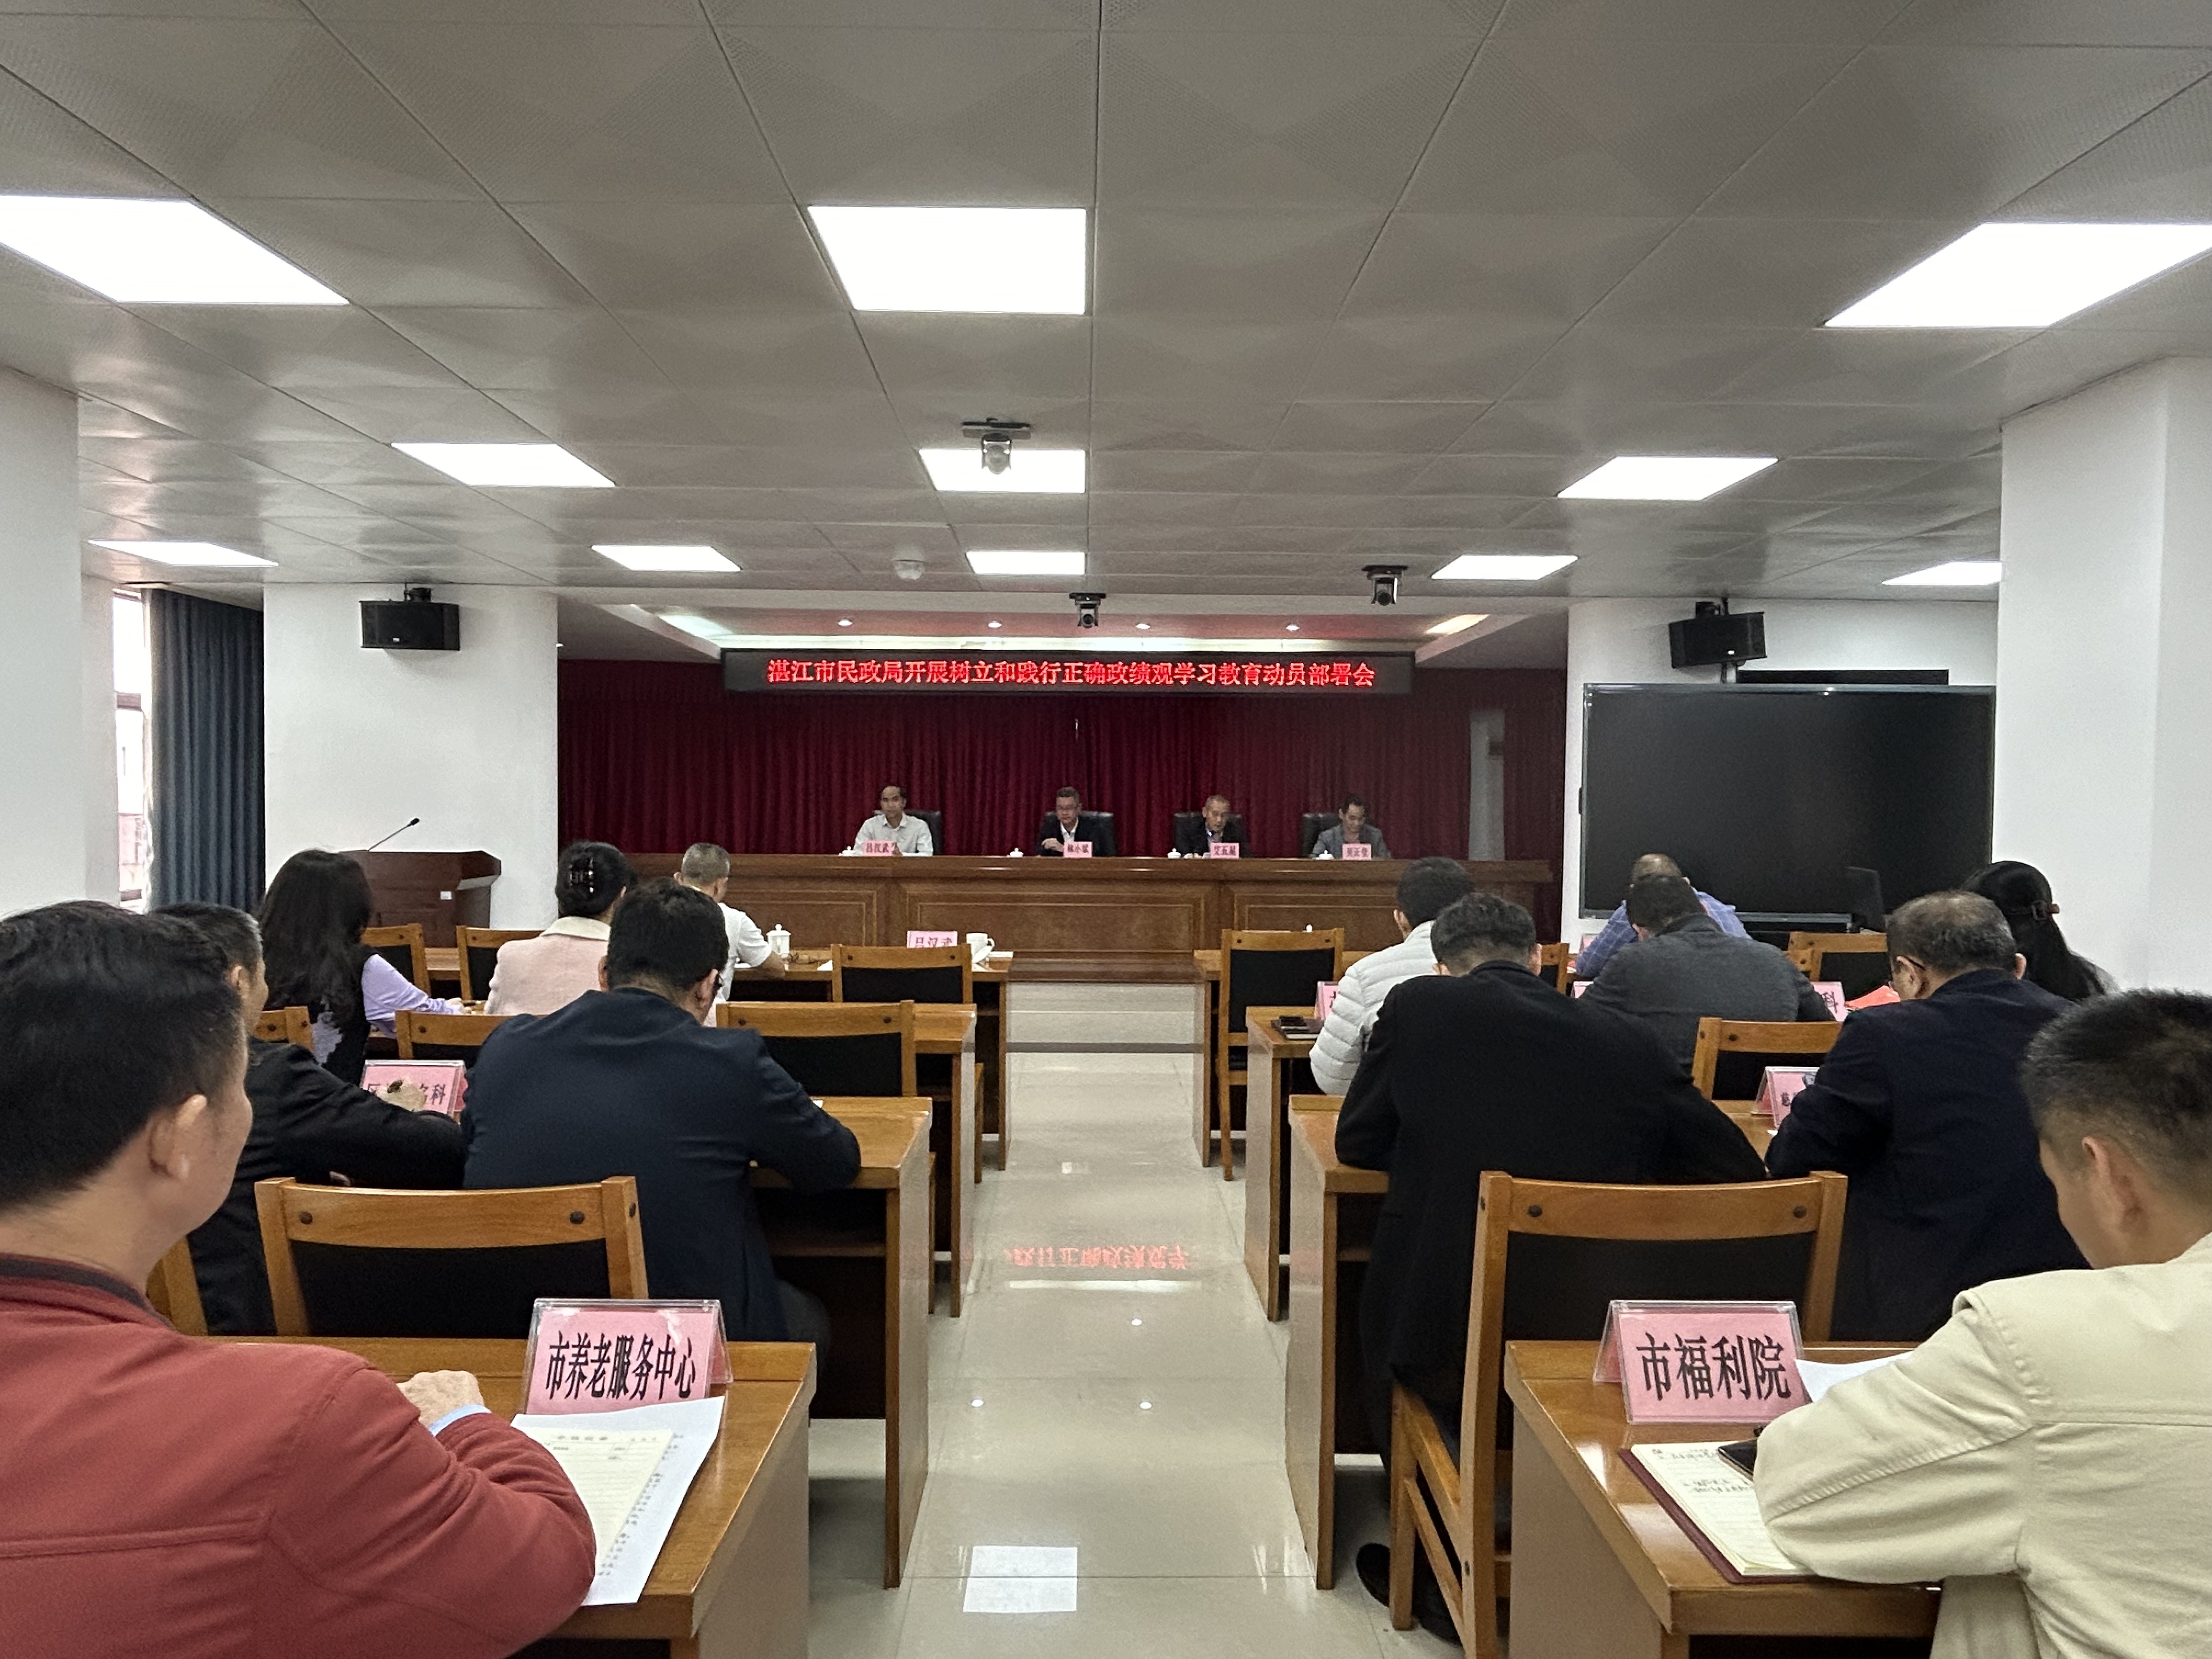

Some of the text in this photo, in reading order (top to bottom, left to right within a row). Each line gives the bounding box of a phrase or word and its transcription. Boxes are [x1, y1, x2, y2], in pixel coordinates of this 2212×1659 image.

[768, 659, 1375, 687] 湛江市民政局开展树立和践行正确政绩观学习教育动员部署会
[545, 1331, 696, 1401] 市养老服务中心
[1637, 1332, 1792, 1401] 市福利院
